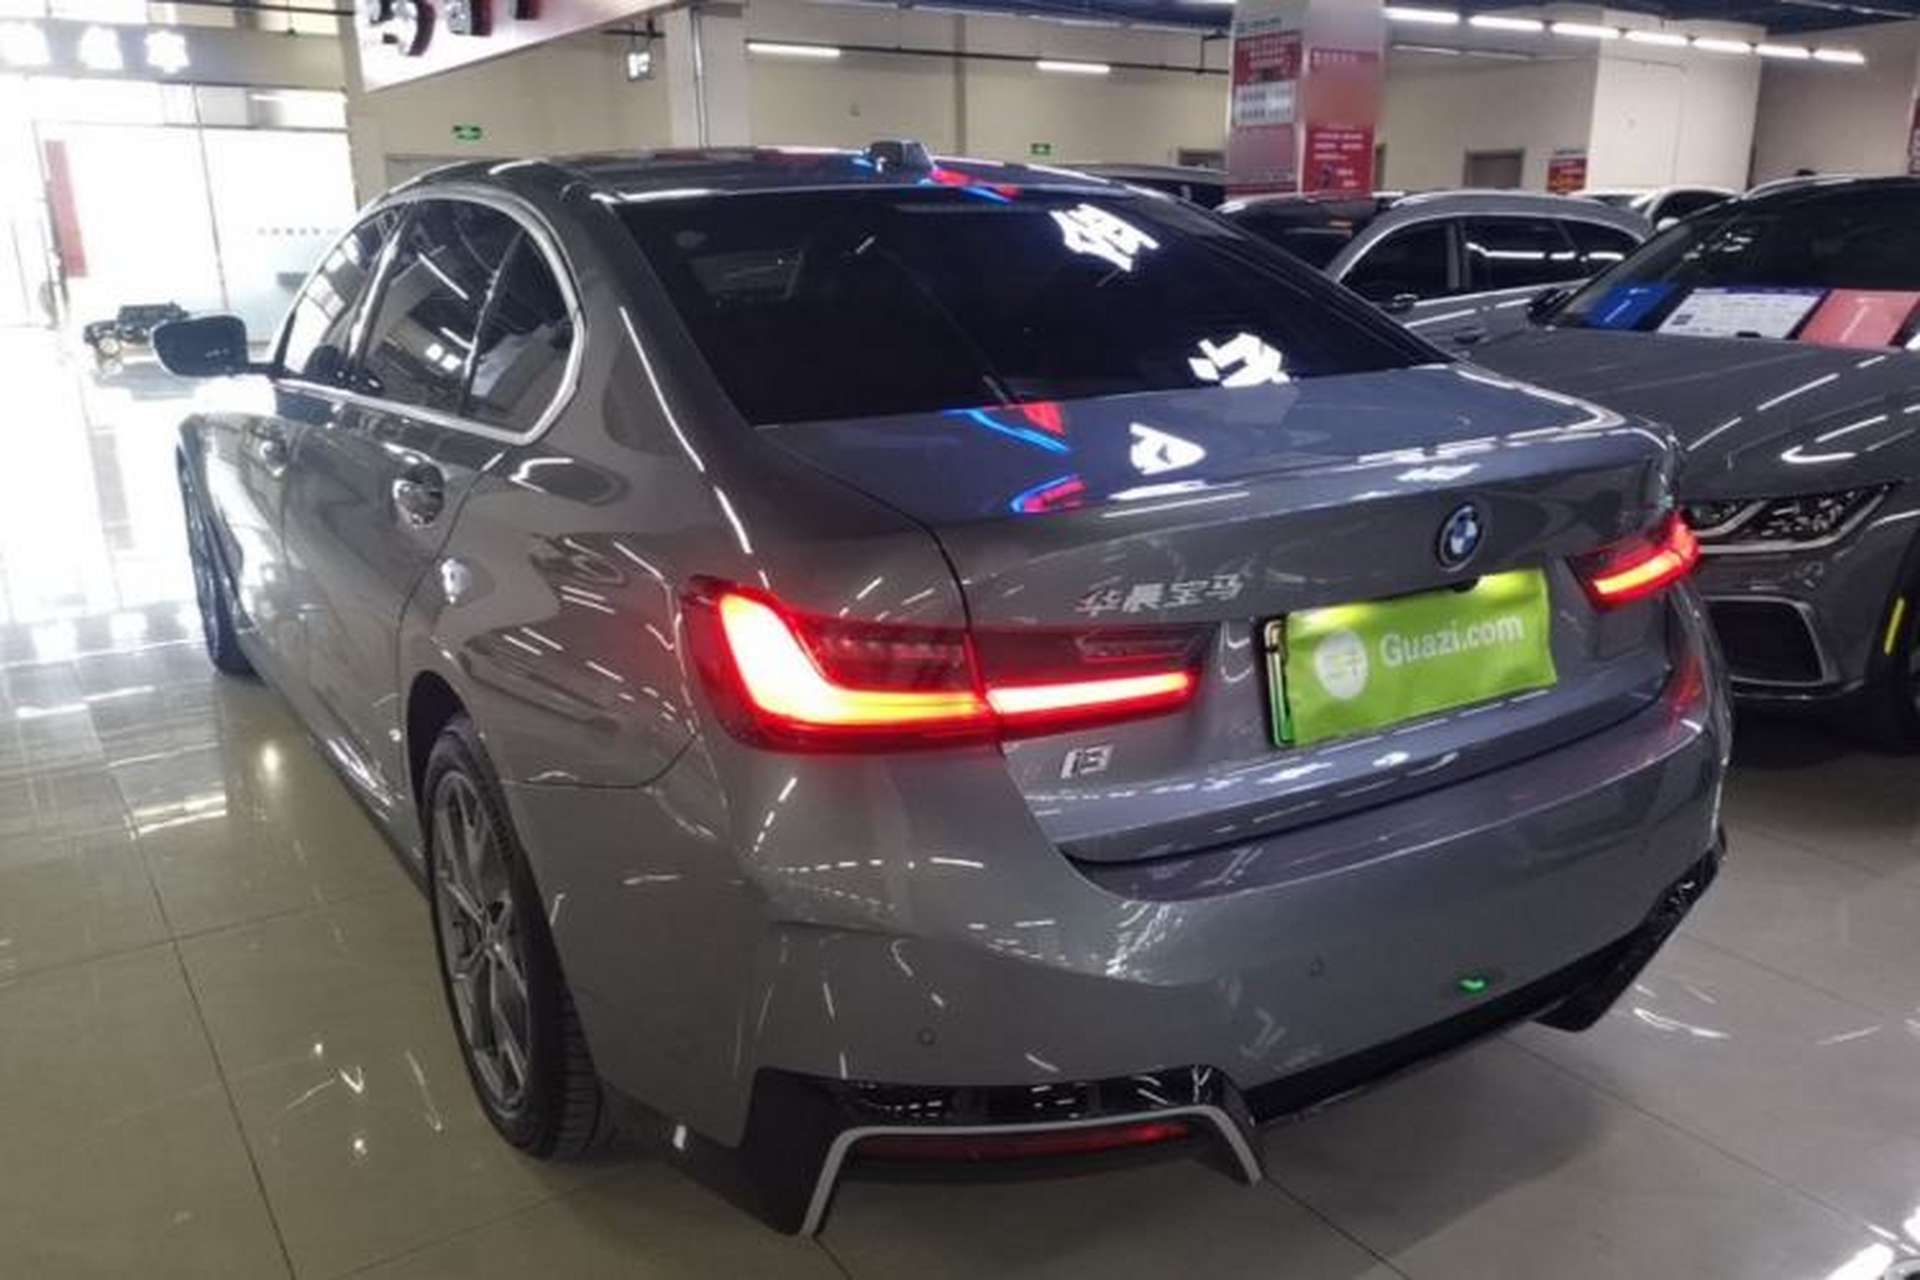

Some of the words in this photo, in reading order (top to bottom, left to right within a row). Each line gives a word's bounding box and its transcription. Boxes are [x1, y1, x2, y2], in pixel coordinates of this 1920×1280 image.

[1074, 573, 1244, 617] 华晨宝马
[1380, 614, 1526, 667] Guazi.com
[1061, 745, 1114, 779] i3
